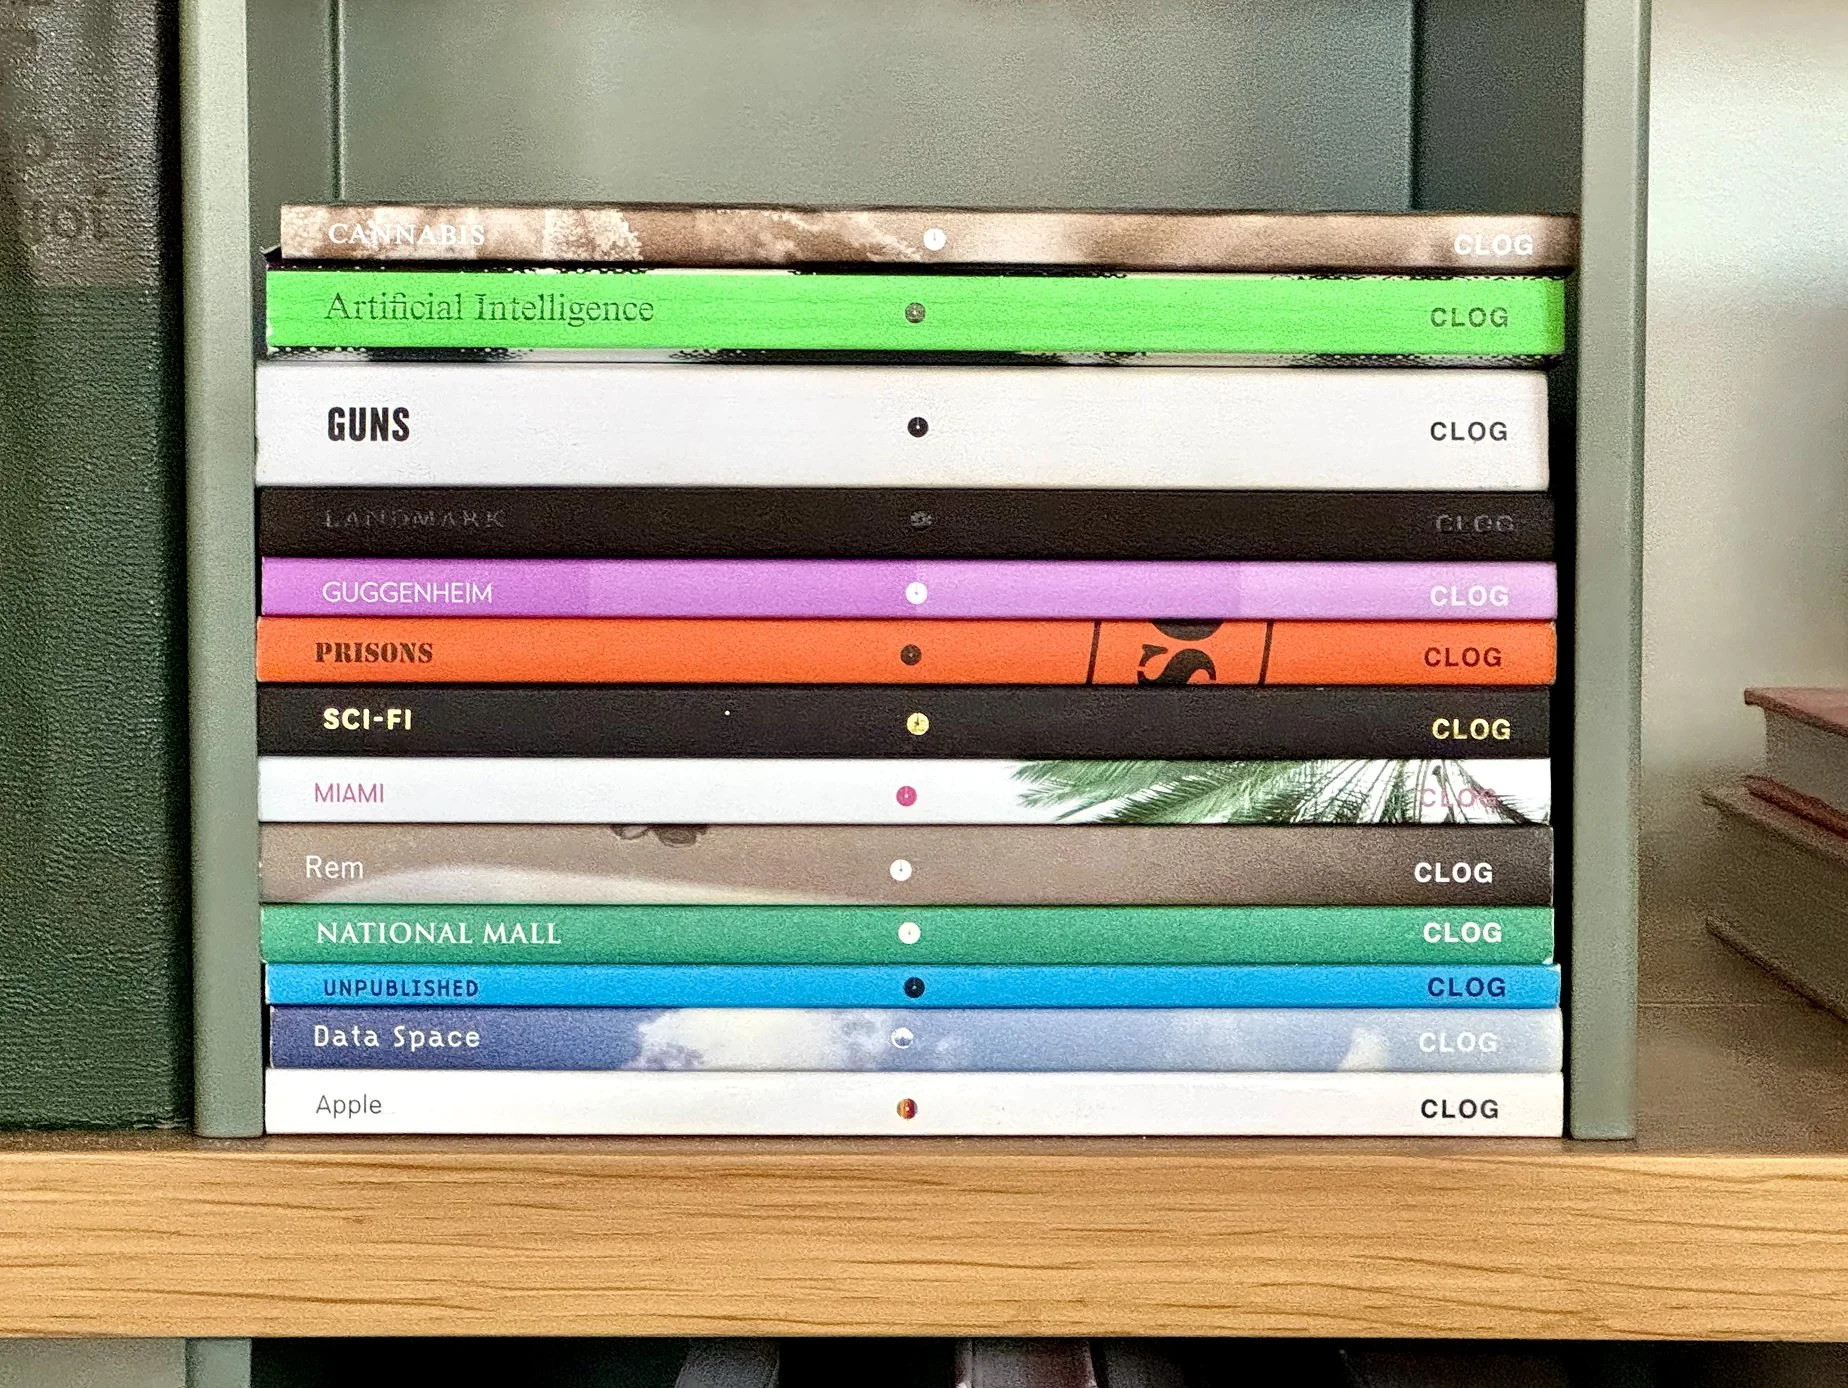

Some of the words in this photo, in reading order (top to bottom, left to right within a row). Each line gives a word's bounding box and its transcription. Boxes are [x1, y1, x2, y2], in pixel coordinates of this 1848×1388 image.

[327, 222, 486, 246] CANNABIS
[1453, 233, 1534, 256] CLOG
[324, 292, 463, 322] Artificial
[474, 292, 654, 327] Intelligence
[1430, 307, 1509, 328] CLOG
[327, 406, 411, 442] GUNS
[1430, 421, 1508, 442] CLOG
[322, 508, 506, 529] LANDMARK
[1435, 514, 1516, 534] CLOG
[322, 581, 493, 604] GUGGENHEIM
[1430, 585, 1510, 607] CLOG
[314, 641, 434, 664] PRISONS
[1423, 646, 1502, 668] CLOG
[322, 707, 413, 731] SCI-FI
[1431, 718, 1512, 741] CLOG
[314, 782, 385, 803] MIAMI
[1420, 787, 1501, 809] CLOG
[305, 854, 365, 880] Rem
[1414, 862, 1494, 883] CLOG
[316, 922, 473, 945] NATIONAL
[483, 921, 562, 945] MALL
[1423, 921, 1502, 943] CLOG
[323, 979, 480, 998] UNPUBLISHED
[1427, 976, 1506, 998] CLOG
[313, 1024, 380, 1048] Data
[393, 1024, 481, 1053] Space
[1419, 1031, 1498, 1053] CLOG
[315, 1093, 383, 1120] Apple
[1420, 1098, 1499, 1120] CLOG
